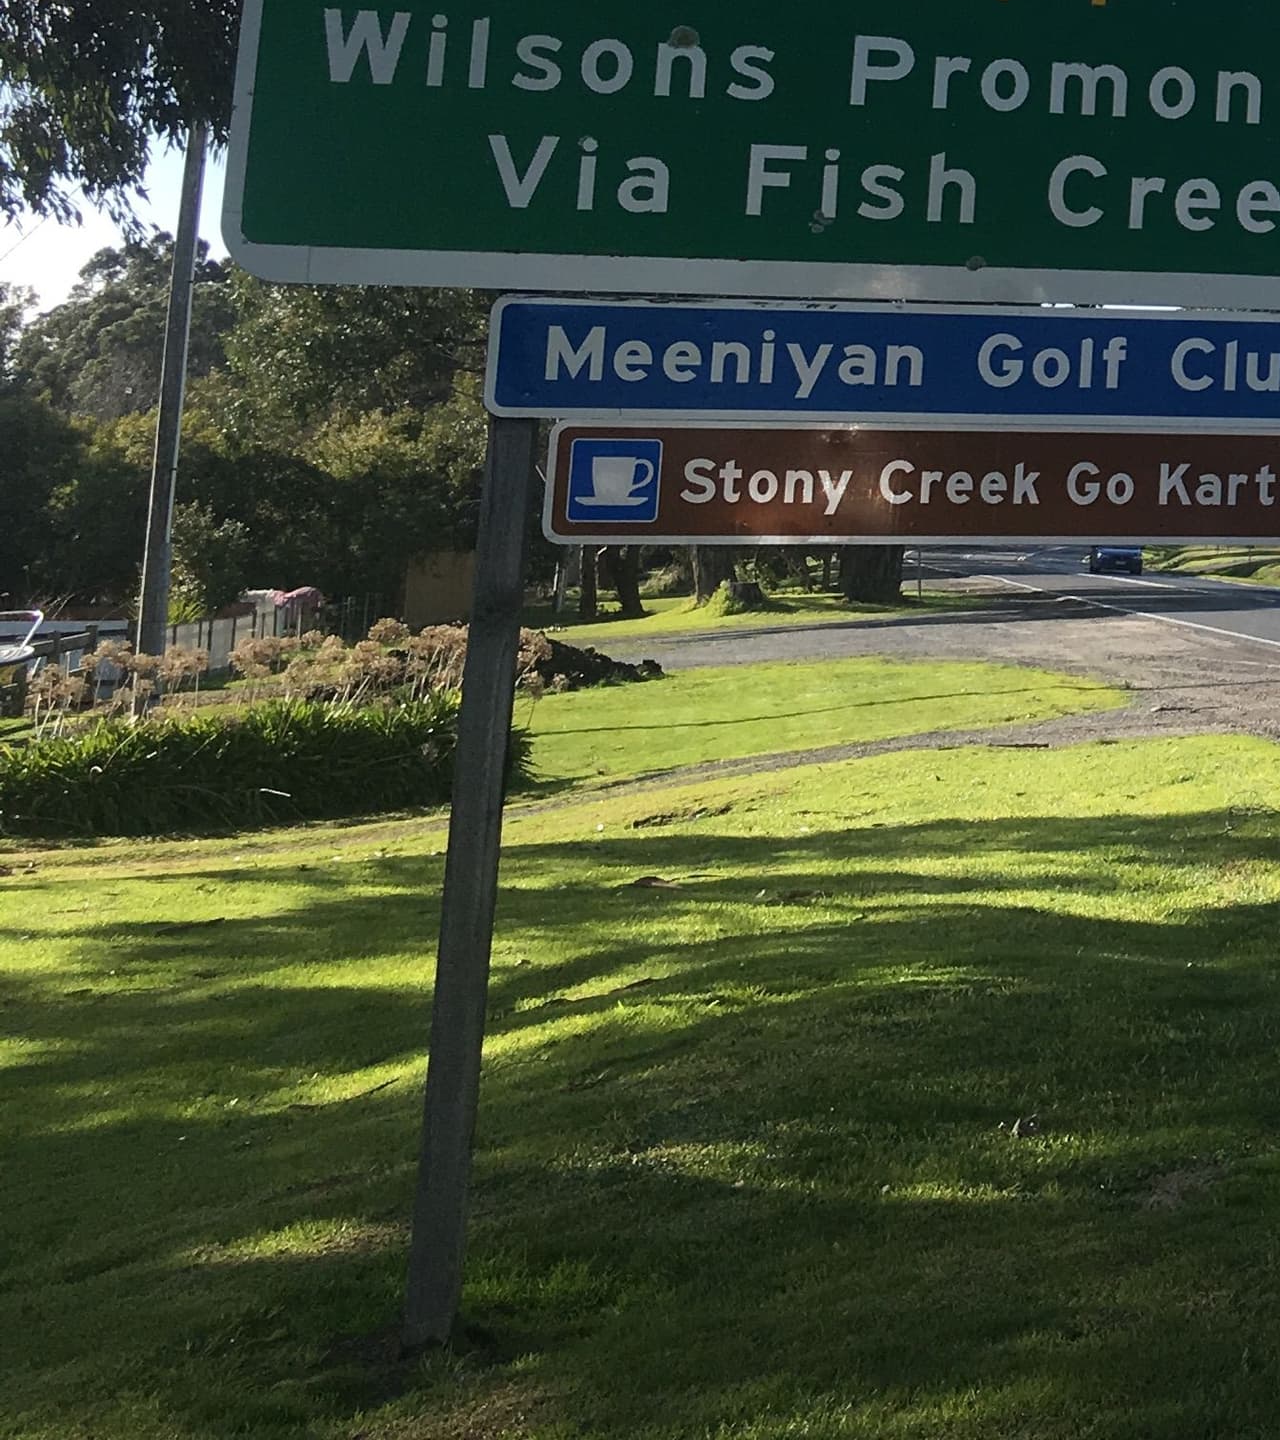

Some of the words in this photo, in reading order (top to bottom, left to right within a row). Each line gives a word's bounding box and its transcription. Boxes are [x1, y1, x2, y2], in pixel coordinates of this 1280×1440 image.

[324, 8, 775, 100] Wilsons
[488, 134, 669, 213] Via
[745, 143, 976, 223] Fish
[545, 325, 924, 399] Meeniyan
[977, 333, 1127, 389] Golf
[681, 457, 854, 516] Stony
[880, 460, 1041, 506] Creek
[1066, 461, 1135, 506] Go
